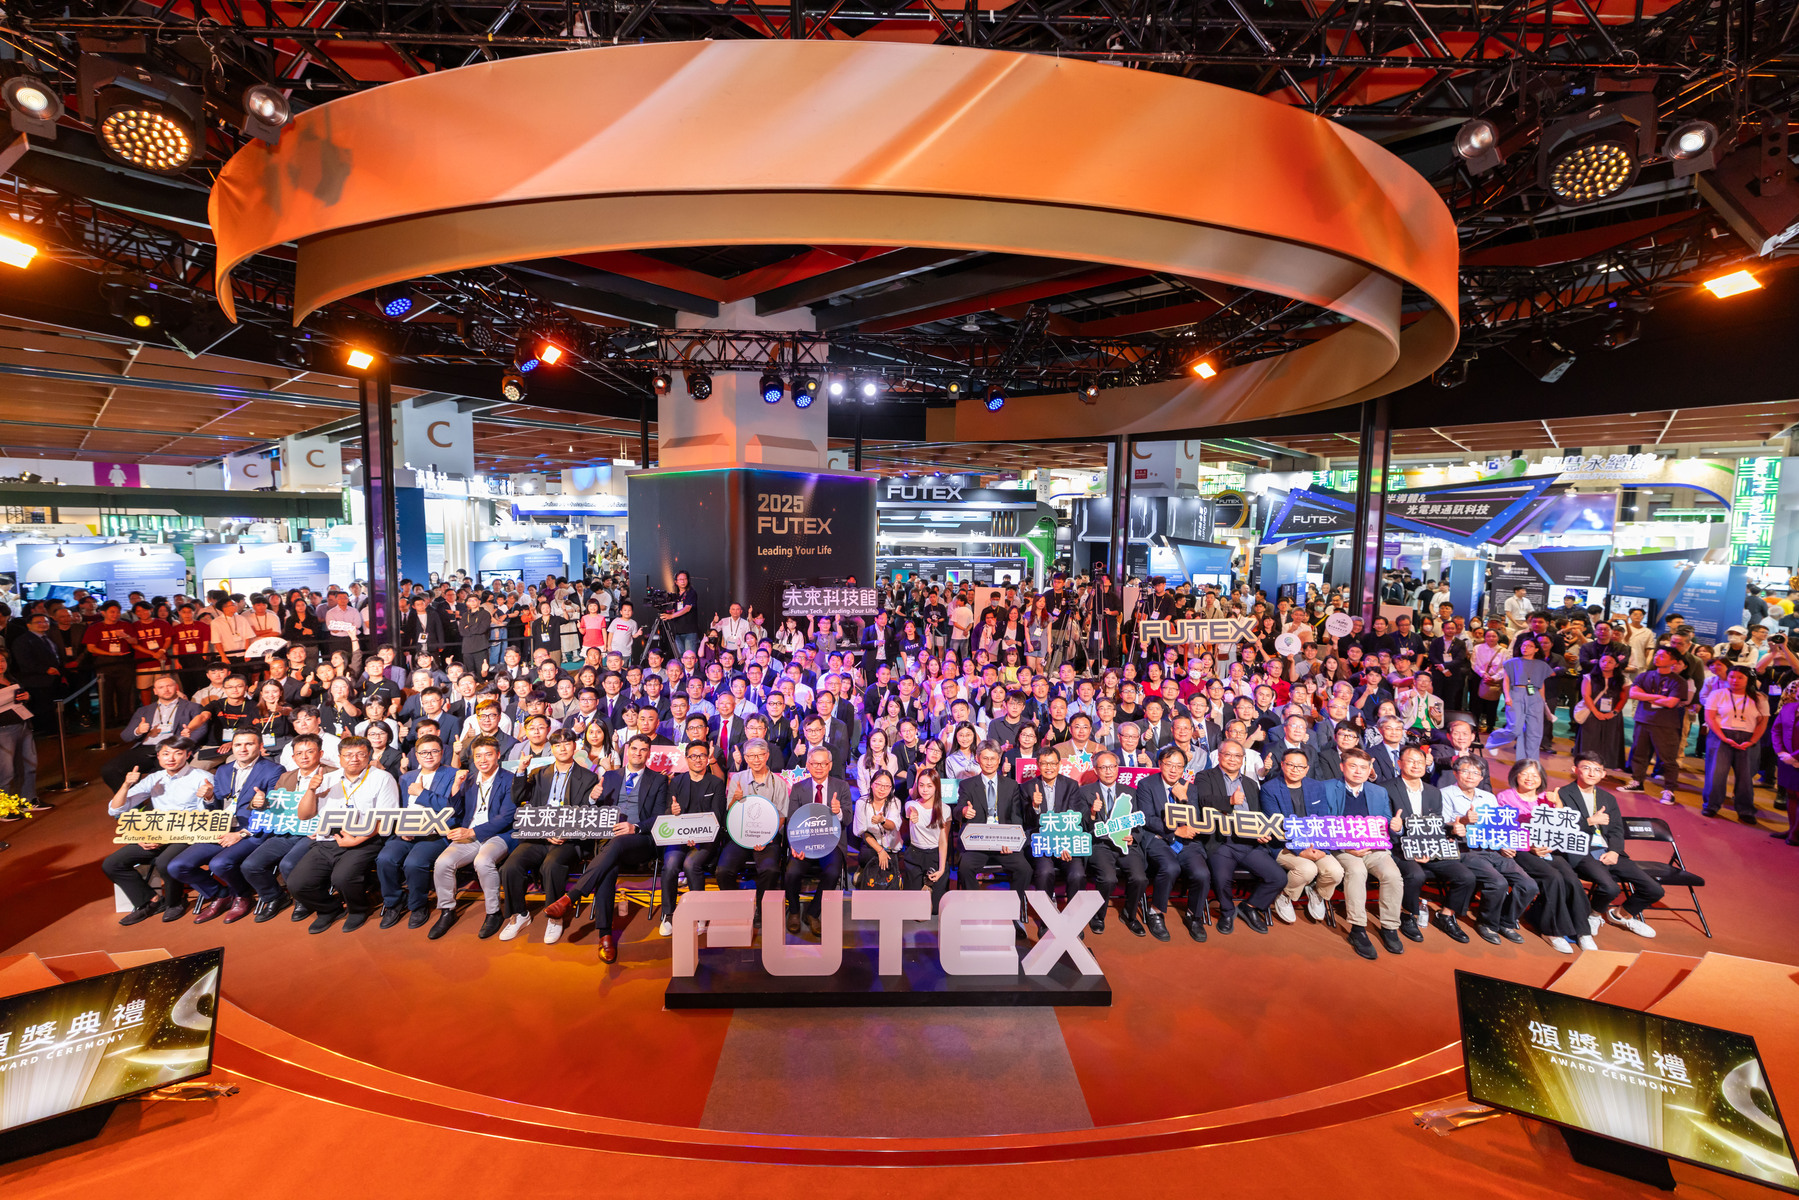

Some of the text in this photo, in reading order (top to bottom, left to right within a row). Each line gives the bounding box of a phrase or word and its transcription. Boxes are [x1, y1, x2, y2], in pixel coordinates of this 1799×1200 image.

[427, 420, 453, 448] C
[306, 449, 327, 468] C
[243, 463, 259, 478] C
[887, 485, 962, 500] FUTEX
[757, 493, 804, 513] 2025
[757, 516, 832, 535] FUTEX
[1292, 515, 1337, 524] FUTEX
[757, 545, 832, 558] Leading Your Life
[784, 588, 877, 606] 未來科技館
[1141, 618, 1258, 645] FUTEX
[647, 751, 681, 766] 科技
[119, 811, 230, 832] 未來科技館
[319, 808, 454, 834] FUTEX
[515, 806, 618, 828] 未來科技館
[804, 819, 827, 828] NSTC
[1041, 812, 1081, 832] 未來
[1095, 811, 1146, 836] 晶創臺灣
[1167, 804, 1284, 840] FUTEX
[1407, 816, 1445, 836] 未來
[1476, 805, 1518, 827] 未來
[1533, 806, 1578, 829] 未來
[562, 830, 586, 838] Leading
[677, 825, 713, 836] COMPAL
[1285, 816, 1388, 838] 未來科技館
[169, 834, 195, 842] Leading
[1033, 835, 1090, 855] 科技館
[1468, 827, 1529, 849] 科技館
[1524, 826, 1589, 853] 科技館
[1403, 839, 1459, 859] 科技館
[672, 890, 1105, 977] FUTEX
[46, 1033, 125, 1060] CEREMONY
[1527, 1020, 1692, 1083] 頒獎典禮
[1550, 1055, 1677, 1095] AWARD CEREMONY
